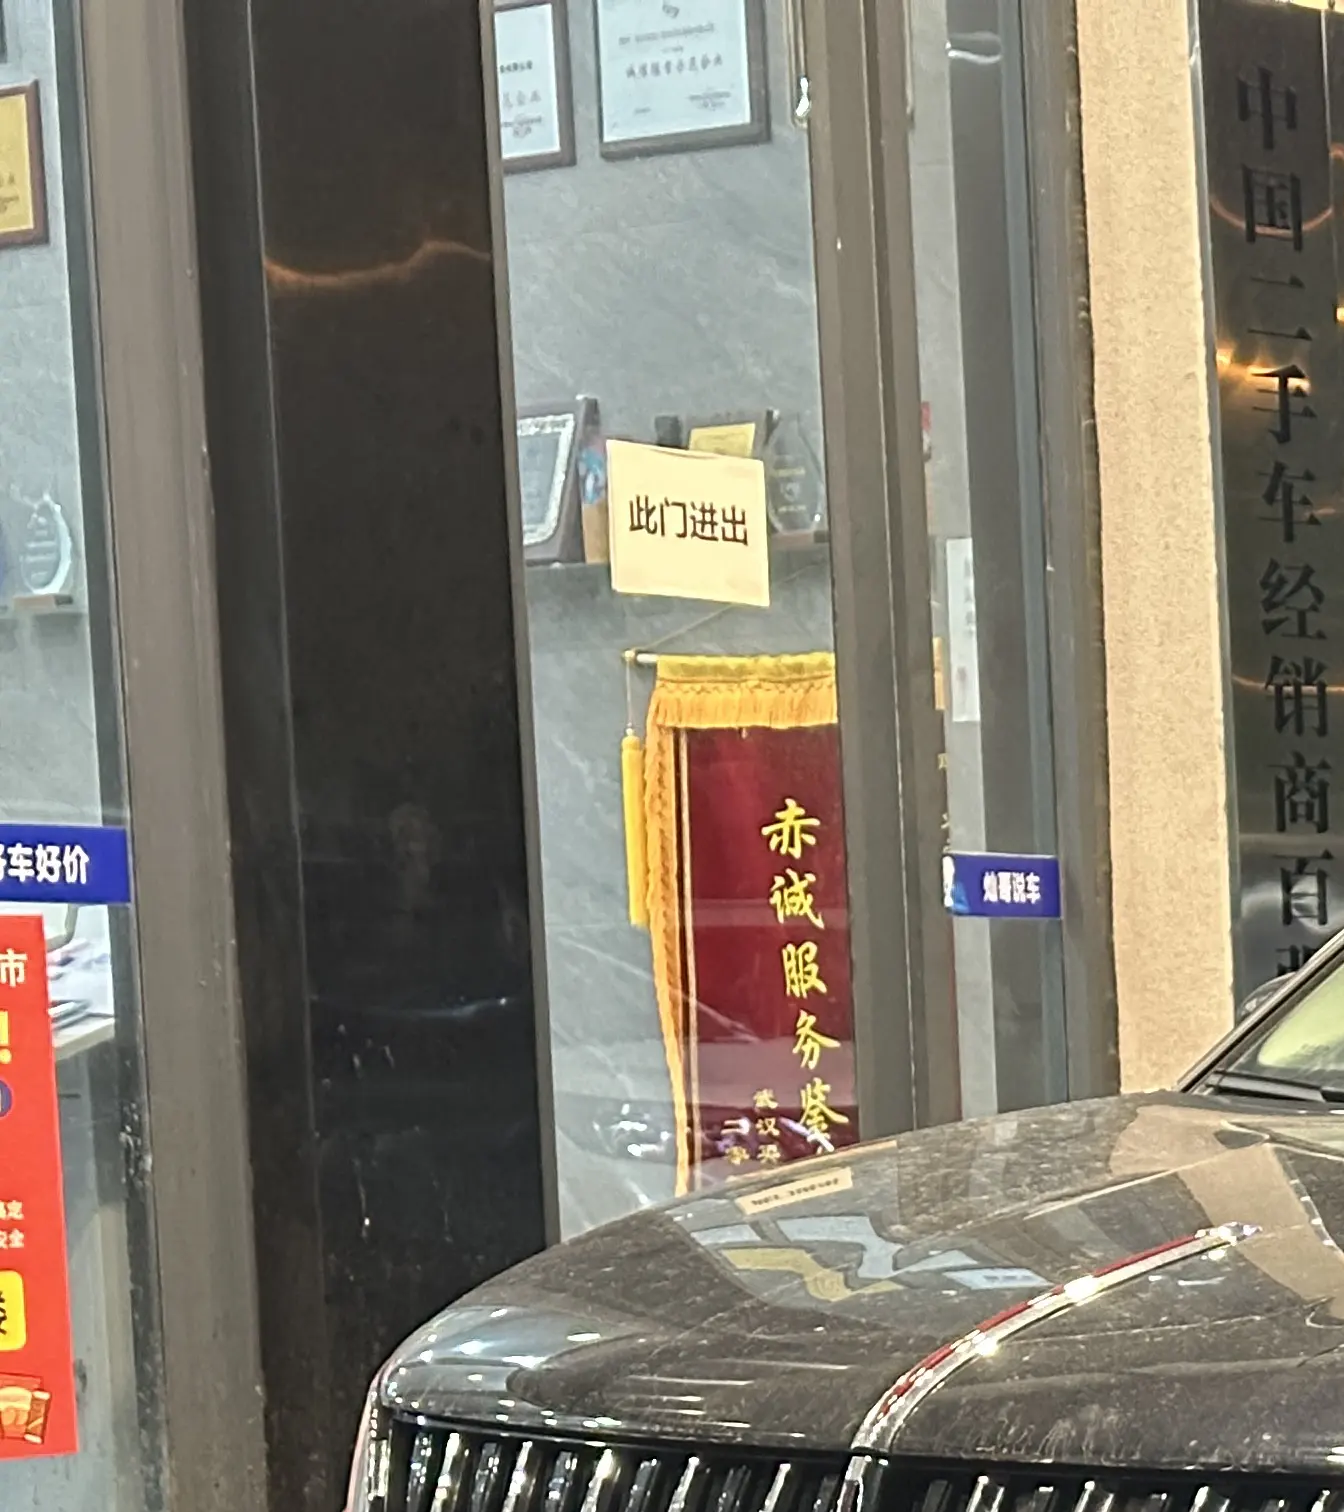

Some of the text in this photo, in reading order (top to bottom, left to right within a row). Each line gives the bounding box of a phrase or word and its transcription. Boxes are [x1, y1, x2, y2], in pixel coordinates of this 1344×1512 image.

[628, 495, 748, 546] 此门进出
[0, 843, 90, 885] 车好价
